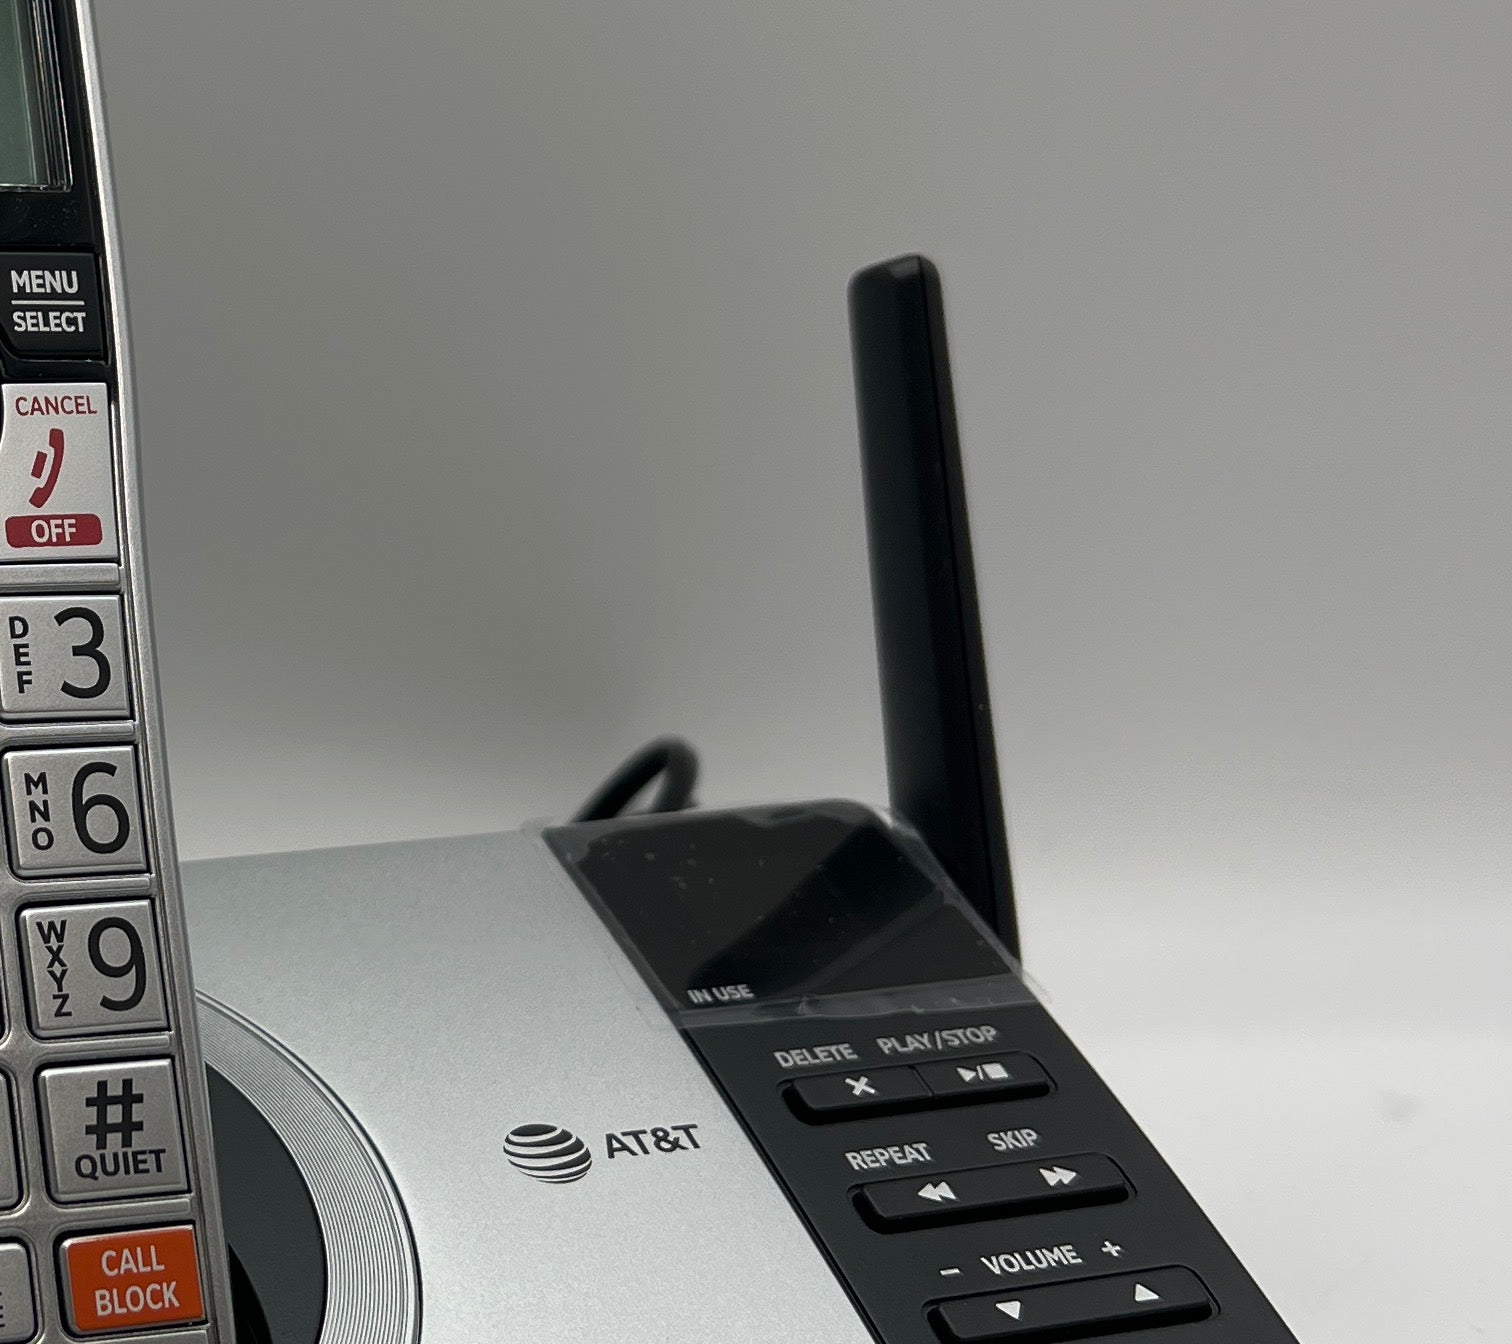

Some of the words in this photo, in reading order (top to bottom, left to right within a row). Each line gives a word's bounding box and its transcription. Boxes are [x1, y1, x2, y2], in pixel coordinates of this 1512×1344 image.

[10, 269, 79, 295] MENU
[12, 310, 86, 334] SELECT
[14, 395, 98, 417] CANCEL
[29, 519, 78, 543] OFF
[8, 615, 34, 694] DEF
[53, 606, 112, 699] 3
[23, 771, 55, 852] MNO
[70, 761, 130, 855] 6
[35, 920, 73, 1018] WXYZ
[87, 916, 147, 1012] 9
[687, 987, 713, 1005] IN
[715, 983, 755, 1002] USE
[875, 1024, 998, 1055] PLAY/STOP
[773, 1043, 859, 1069] DELETE
[84, 1078, 145, 1151] #
[604, 1122, 701, 1162] AT&T
[986, 1128, 1039, 1152] SKIP
[74, 1147, 167, 1181] QUIET
[845, 1142, 932, 1171] REPEAT
[100, 1245, 166, 1275] CALL
[980, 1244, 1084, 1276] VOLUME
[94, 1282, 181, 1318] BLOCK
